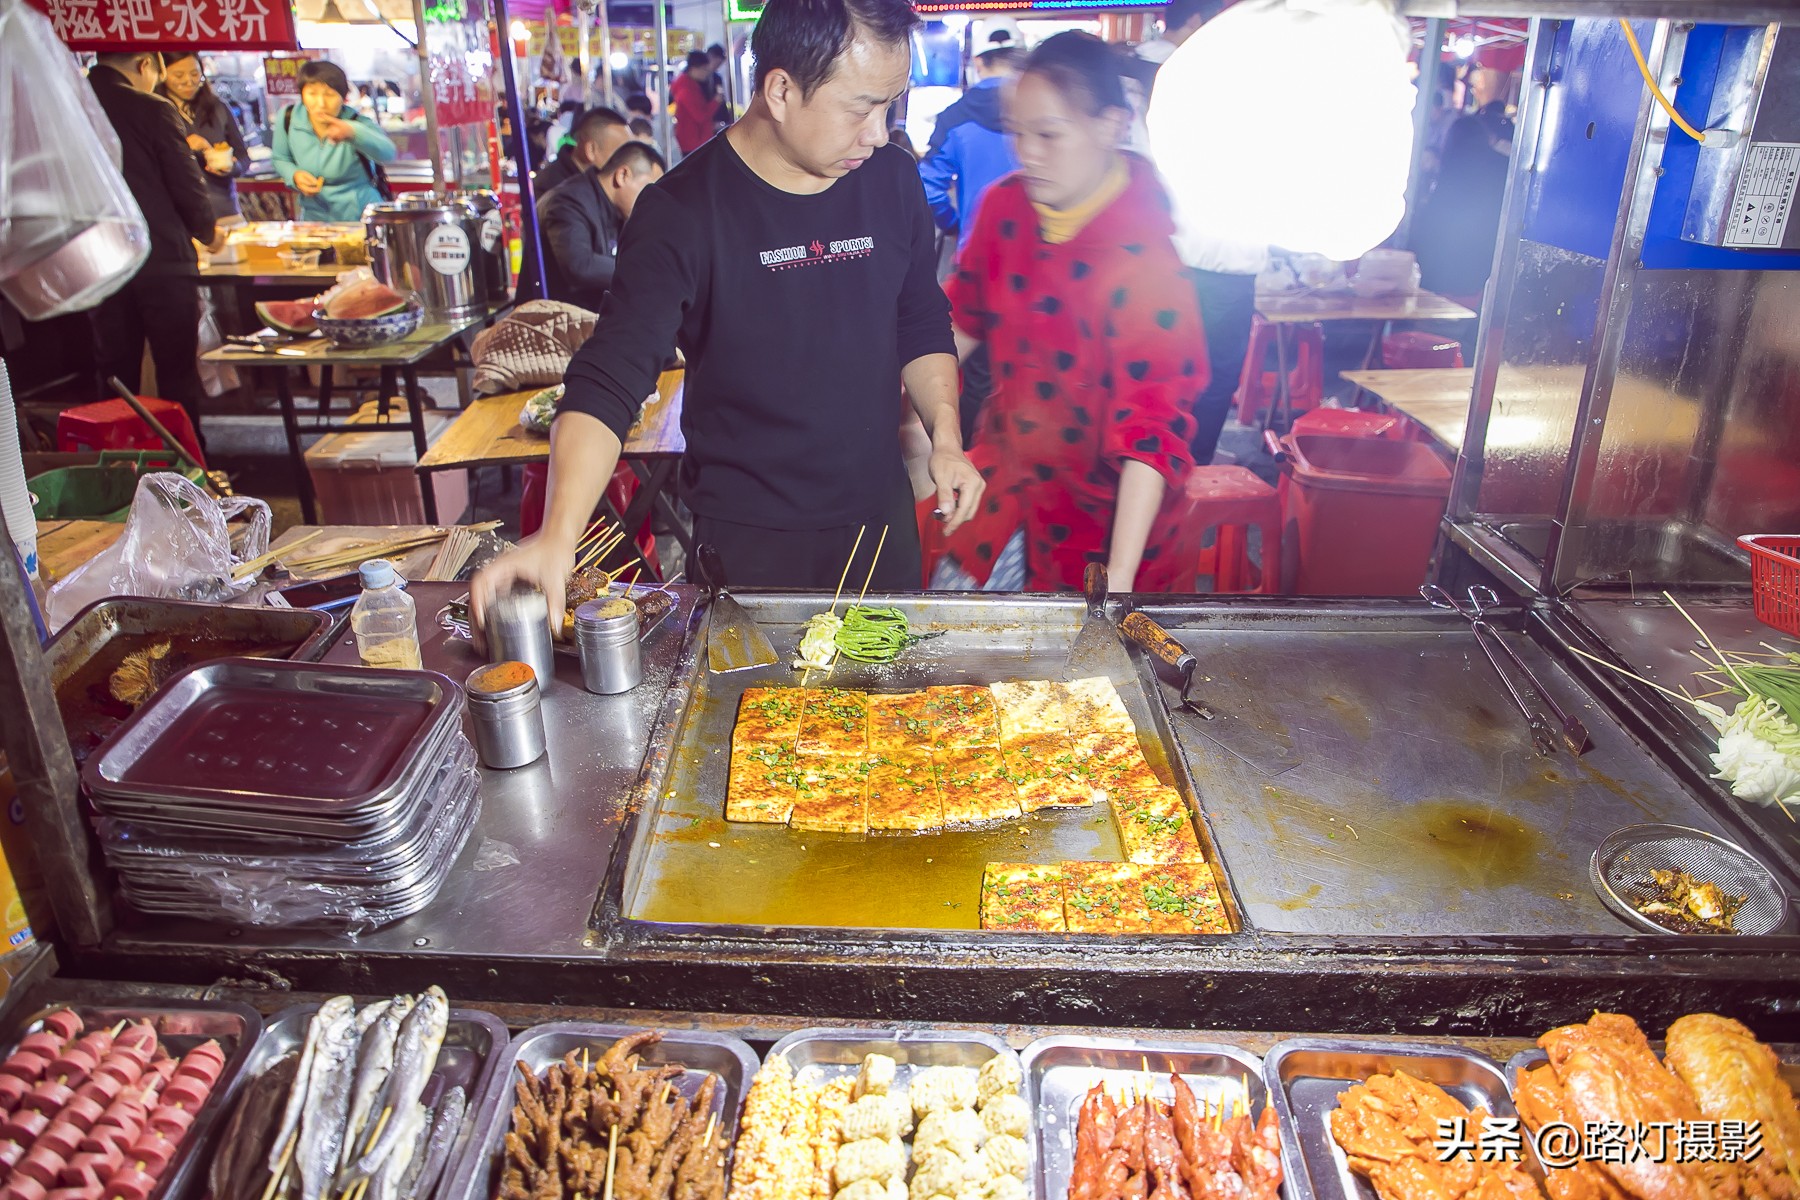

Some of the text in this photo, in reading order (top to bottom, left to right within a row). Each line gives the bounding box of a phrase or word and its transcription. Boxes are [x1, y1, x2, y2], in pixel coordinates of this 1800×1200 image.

[50, 0, 269, 42] 糍粑冰粉
[760, 246, 807, 265] FASHION
